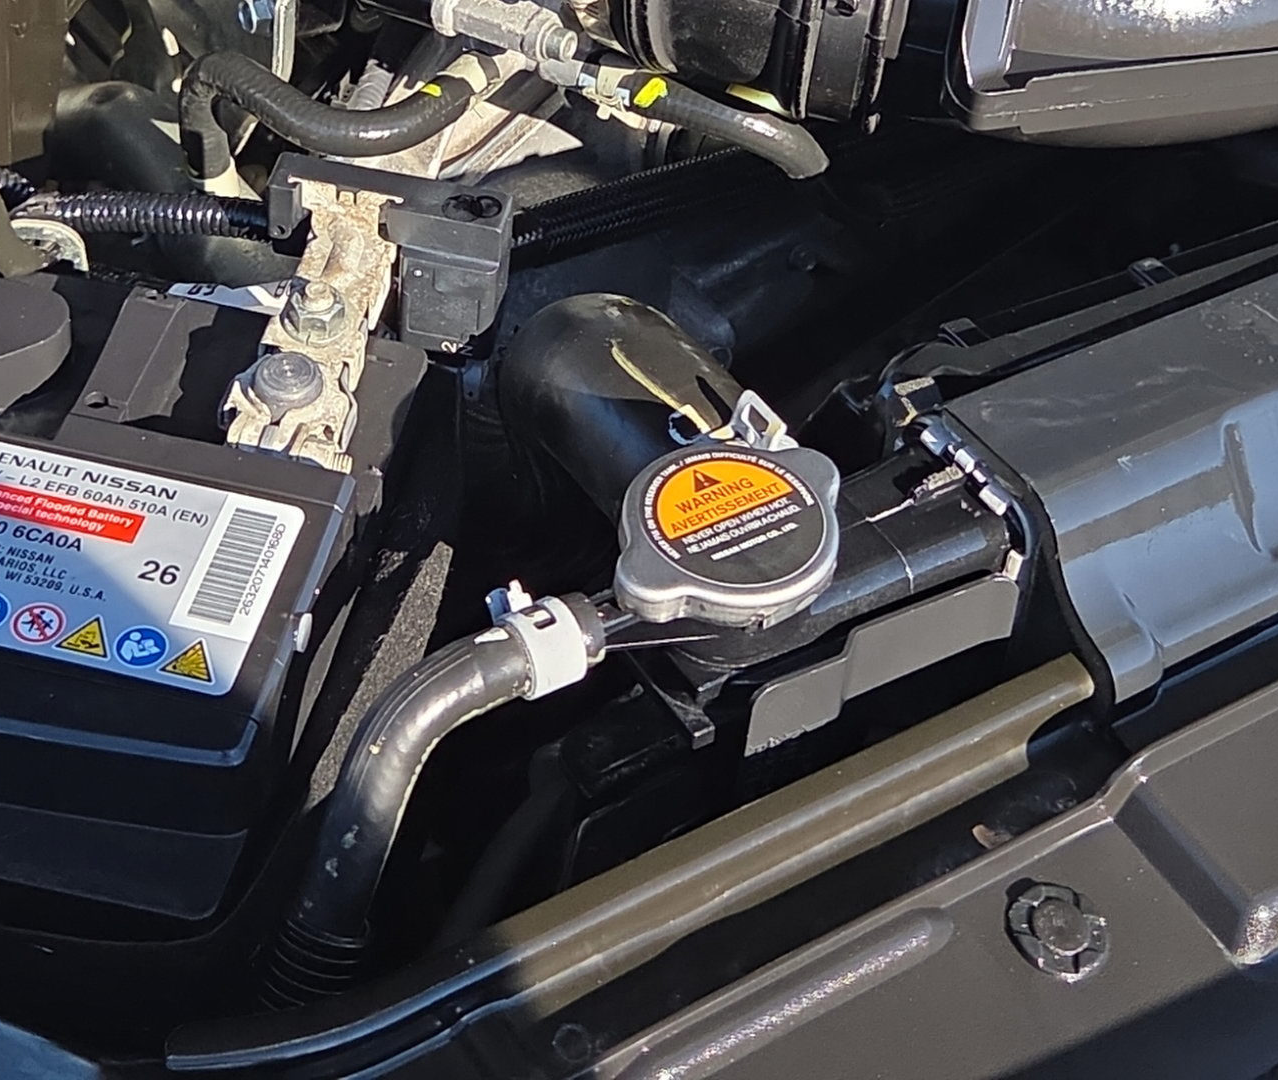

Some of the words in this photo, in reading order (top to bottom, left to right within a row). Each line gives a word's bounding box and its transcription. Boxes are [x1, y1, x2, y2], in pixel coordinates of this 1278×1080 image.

[81, 470, 177, 500] NISSAN
[675, 476, 753, 515] WARNING
[19, 475, 41, 487] L2
[44, 481, 79, 495] EFB
[82, 489, 125, 506] 60Ah
[128, 499, 169, 516] 510A
[171, 508, 210, 527] (EN)
[34, 497, 85, 515] Flooded
[86, 509, 134, 527] Battery
[670, 482, 781, 533] AVERTISSEMENT
[34, 508, 106, 532] technology
[681, 526, 714, 545] NEVER
[712, 516, 740, 533] OPEN
[738, 504, 770, 522] WHEN
[768, 495, 792, 510] HOT.
[698, 531, 731, 550] JAMAIS
[728, 518, 763, 538] OUVRIR
[6, 546, 54, 564] NISSAN
[710, 544, 740, 561] NISSAN
[738, 533, 767, 550] MOTOR
[3, 570, 22, 582] WI
[22, 574, 68, 592] 53209,
[68, 585, 108, 601] U.S.A.
[42, 567, 67, 579] LLC
[137, 560, 181, 585] 26
